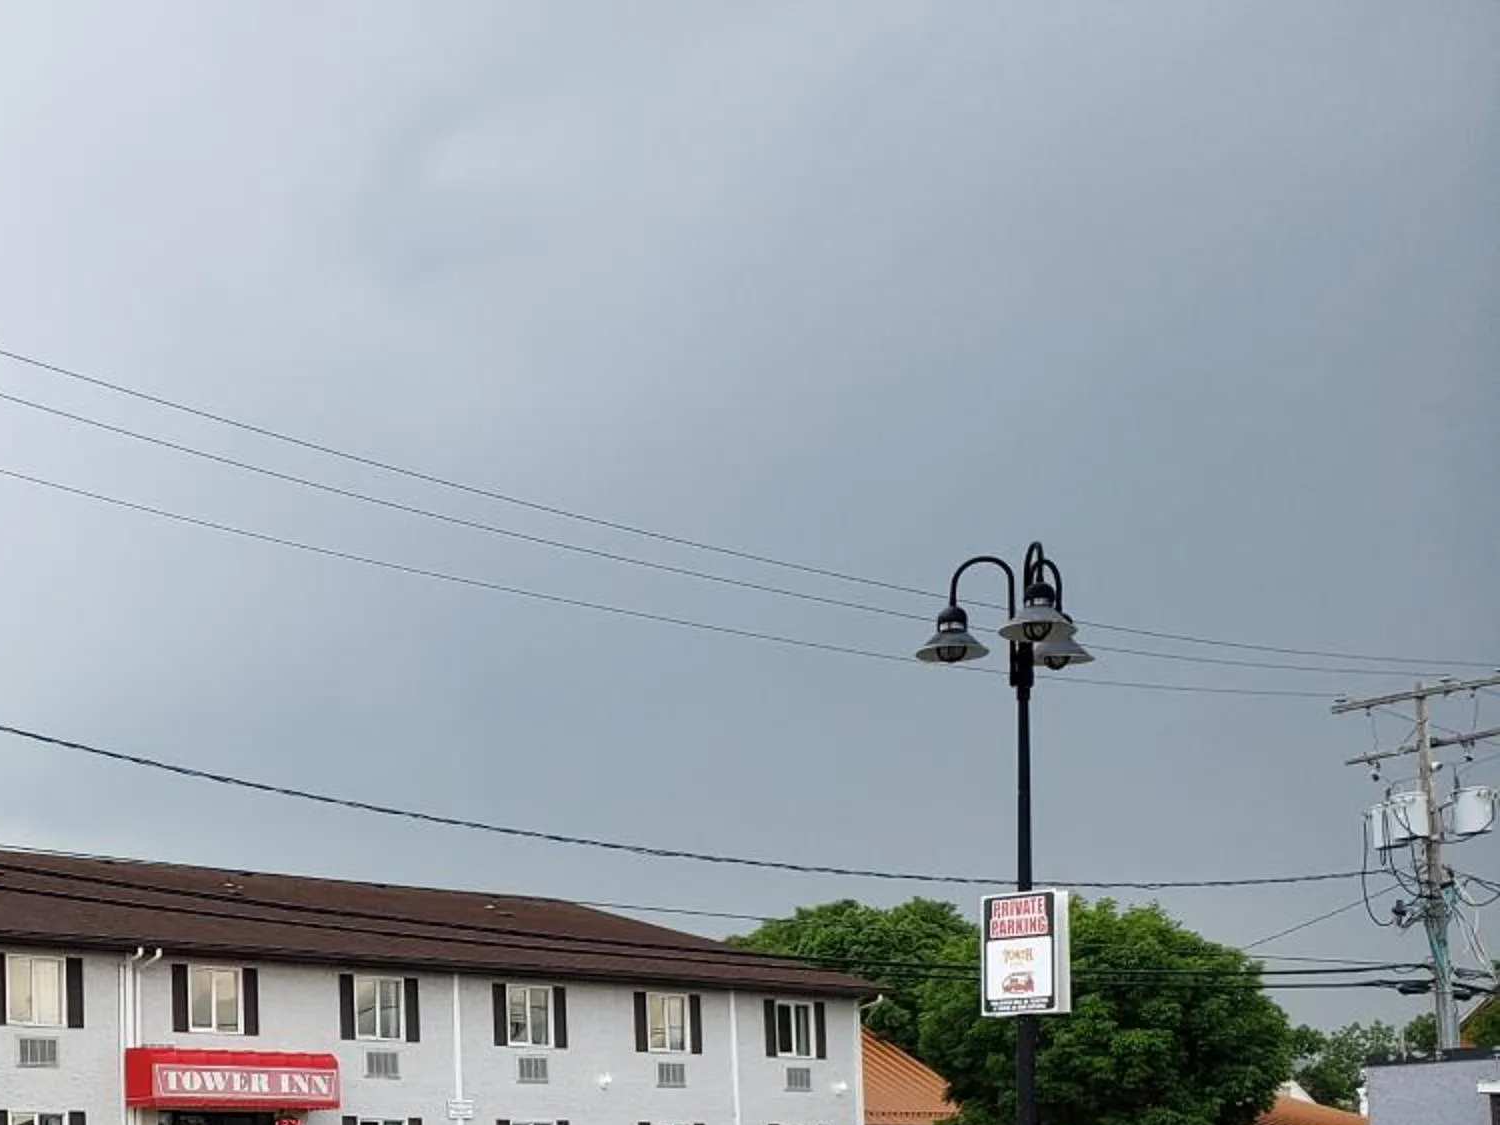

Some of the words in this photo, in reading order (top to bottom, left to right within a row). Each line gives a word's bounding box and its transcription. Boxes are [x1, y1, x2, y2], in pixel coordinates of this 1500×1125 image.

[993, 897, 1044, 918] PRIVATE
[991, 916, 1046, 937] PARKING
[163, 1070, 270, 1094] TOWER
[280, 1072, 331, 1095] INN
